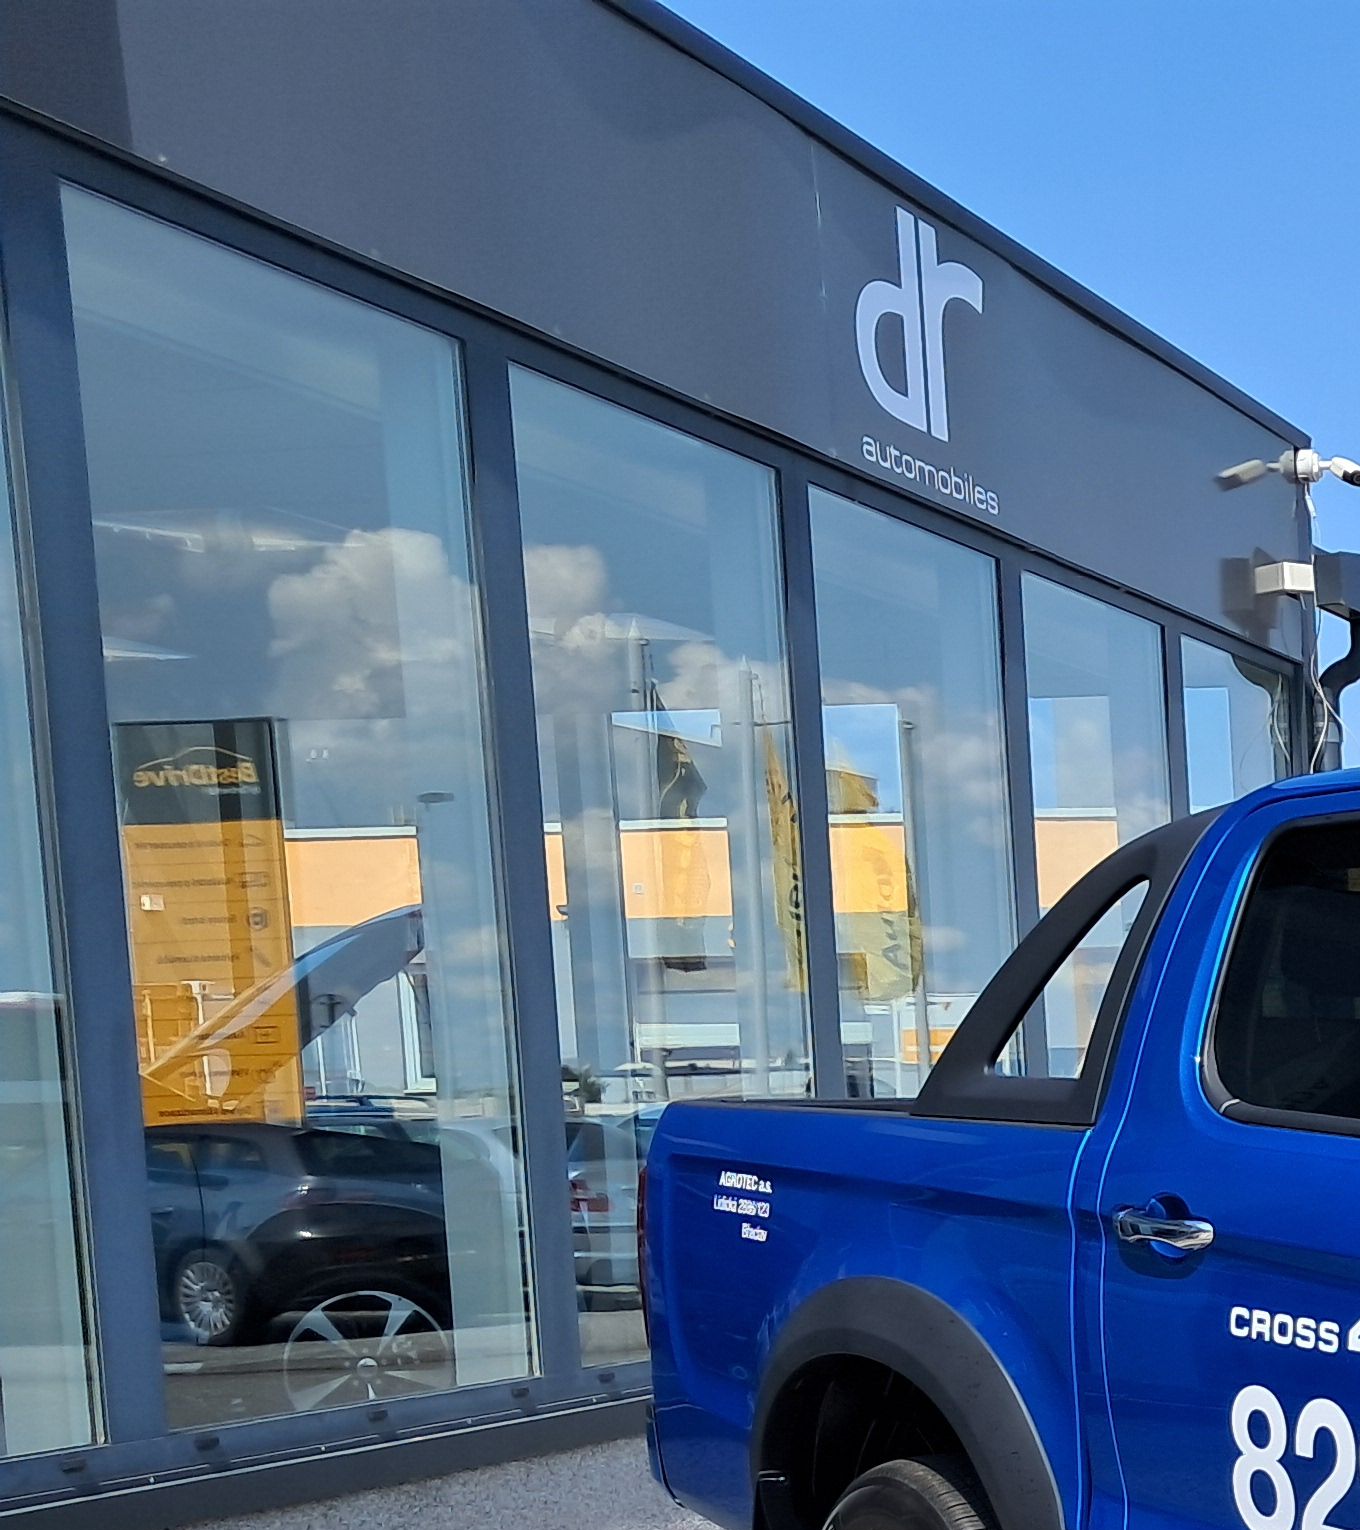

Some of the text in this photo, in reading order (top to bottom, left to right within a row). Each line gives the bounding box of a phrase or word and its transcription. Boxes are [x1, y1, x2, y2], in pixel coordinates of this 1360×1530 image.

[855, 205, 983, 443] dr
[862, 435, 999, 516] automobiles
[1229, 1305, 1340, 1353] CROSS
